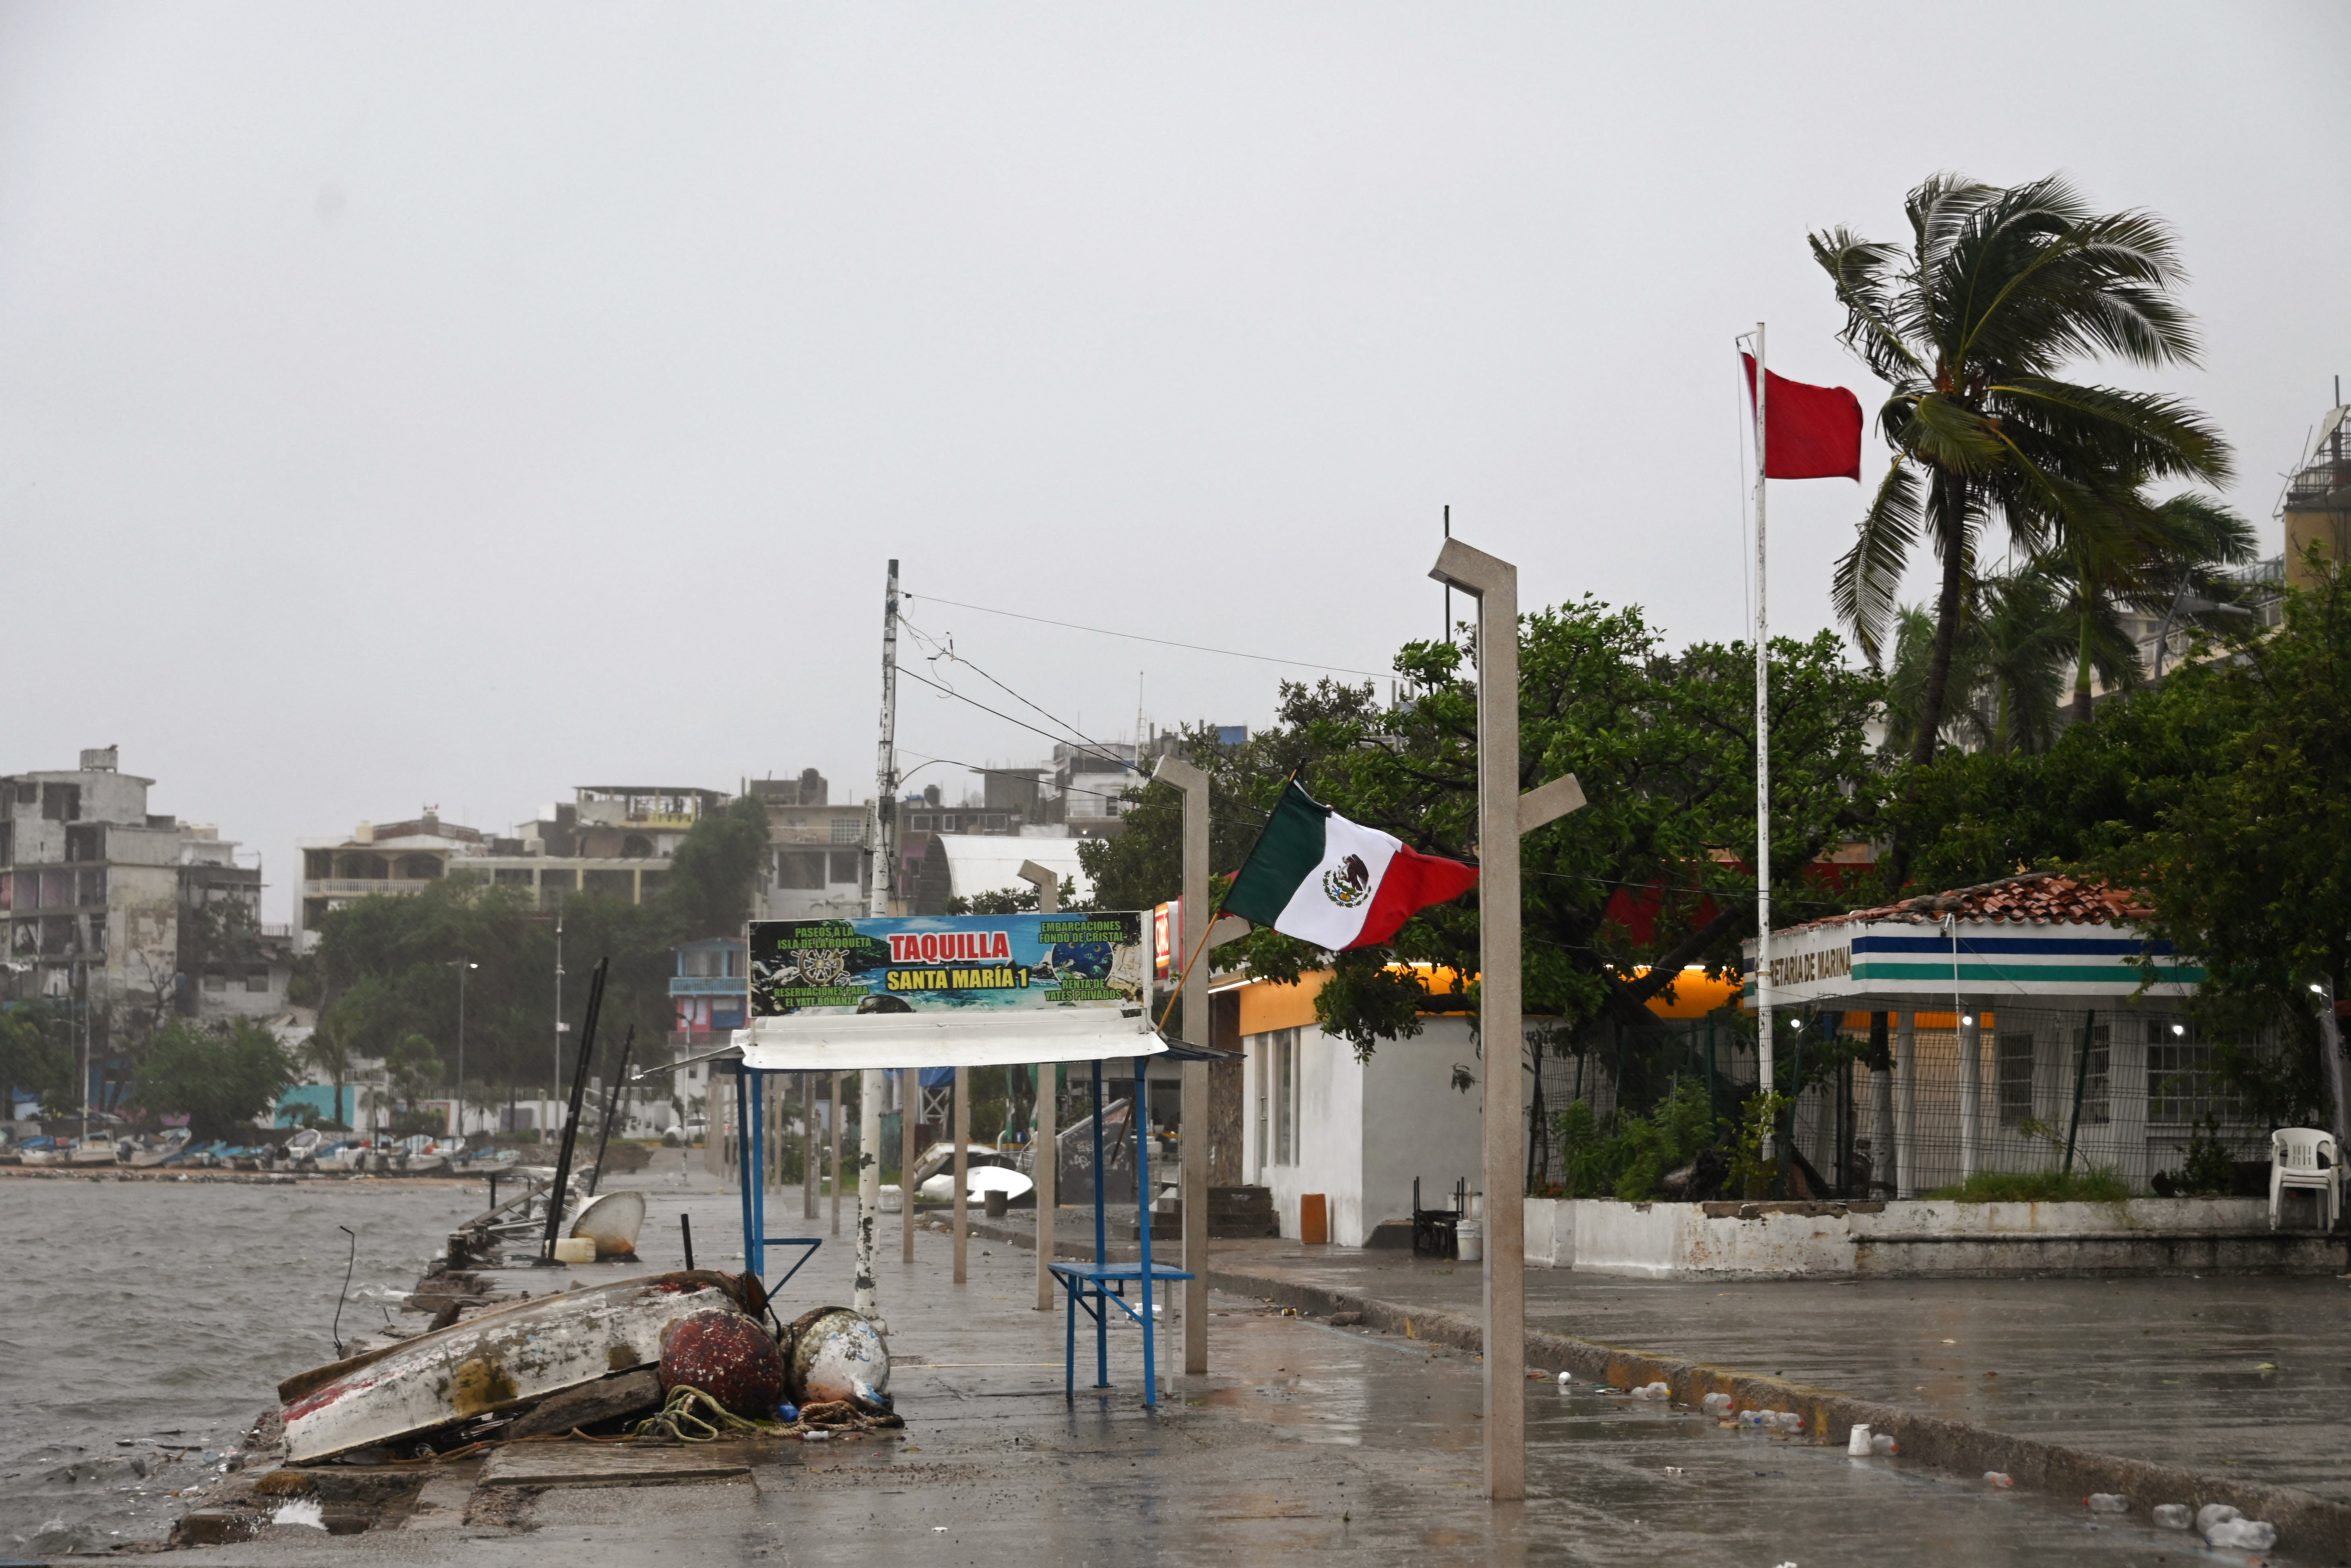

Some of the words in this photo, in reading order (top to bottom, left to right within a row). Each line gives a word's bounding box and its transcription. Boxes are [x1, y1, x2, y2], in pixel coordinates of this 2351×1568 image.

[795, 927, 832, 937] PASEOS
[834, 927, 841, 936] A
[843, 926, 854, 936] LA
[1041, 921, 1121, 932] EMBARCACIONES
[778, 939, 799, 949] ISLA
[801, 939, 814, 948] DE
[816, 939, 827, 947] LA
[829, 937, 872, 948] ROQUETA
[1039, 933, 1070, 943] FONDO
[1072, 933, 1084, 942] DE
[1086, 932, 1124, 941] CRISTAL
[885, 933, 1009, 962] TAQUILLA
[1755, 949, 1804, 989] SRETARÍA
[1804, 953, 1815, 982] DE
[1818, 945, 1851, 980] MARINA
[887, 970, 948, 990] SANTA
[952, 966, 1015, 988] MARÍA
[1018, 968, 1027, 987] 1
[1062, 980, 1091, 989] RENTA
[1093, 979, 1105, 988] DE
[774, 986, 844, 997] RESERVACIONES
[846, 986, 869, 995] PARA
[1045, 990, 1073, 1001] YATES
[1075, 989, 1122, 1000] PRIVADOS
[785, 999, 795, 1007] EL
[796, 997, 816, 1006] YATE
[817, 996, 858, 1006] BONANZA
